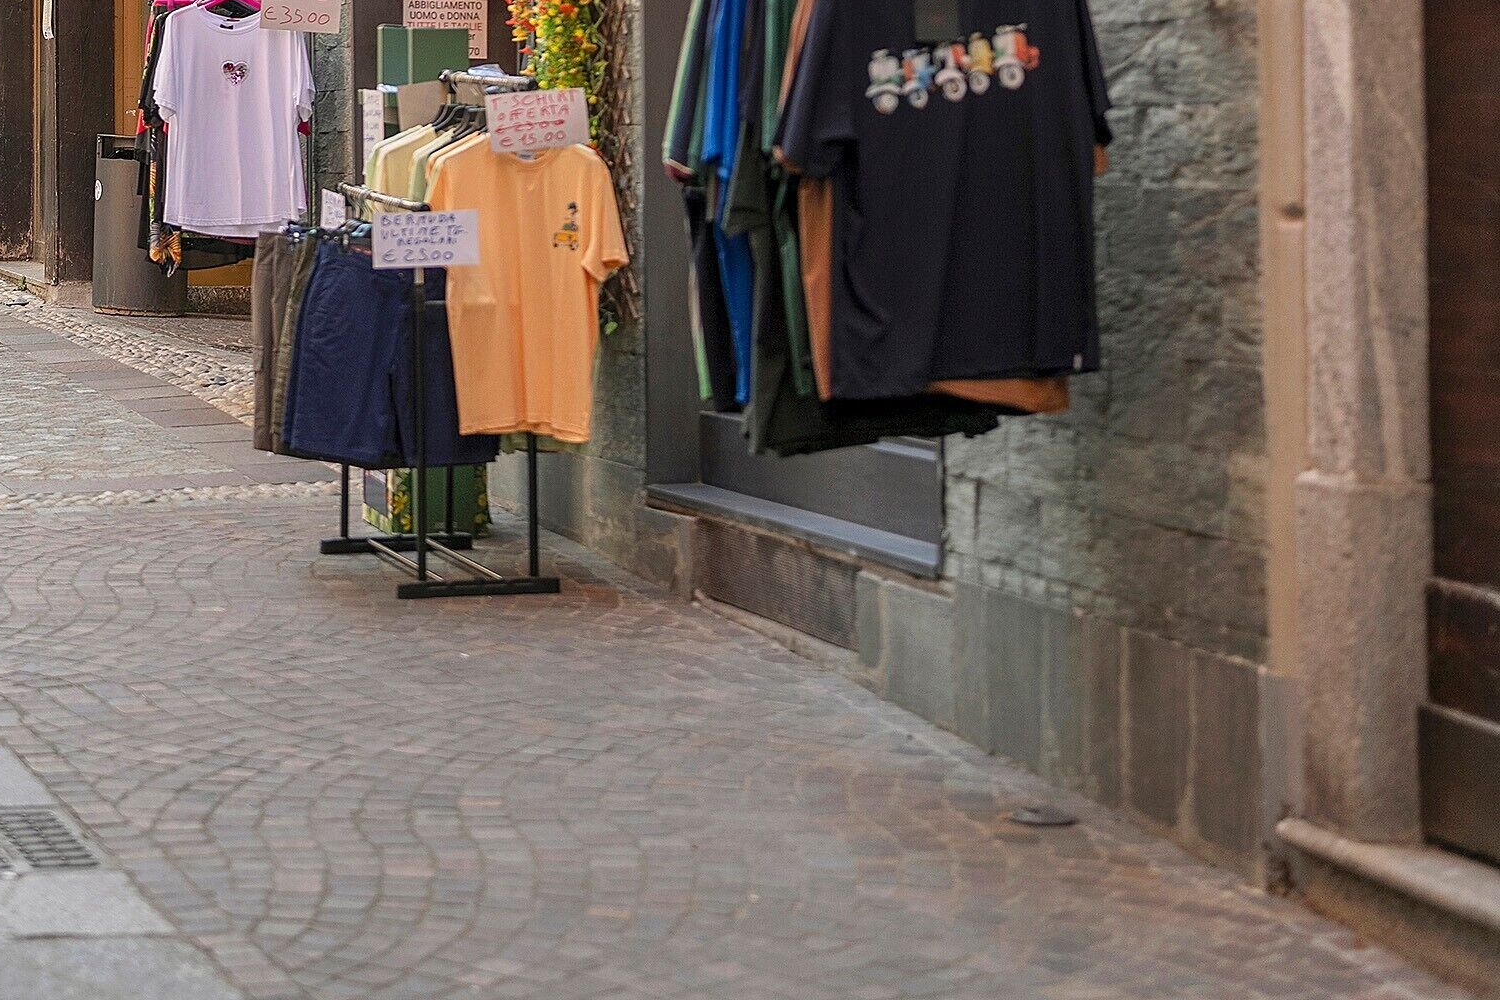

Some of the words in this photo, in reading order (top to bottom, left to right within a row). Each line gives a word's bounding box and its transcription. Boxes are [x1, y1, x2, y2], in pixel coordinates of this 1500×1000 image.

[408, 0, 483, 10] ABBIGLIAMENTO
[409, 11, 438, 20] UOMO
[446, 11, 480, 20] DONNA
[381, 213, 456, 226] BERMUDA
[380, 225, 440, 240] ULTIME
